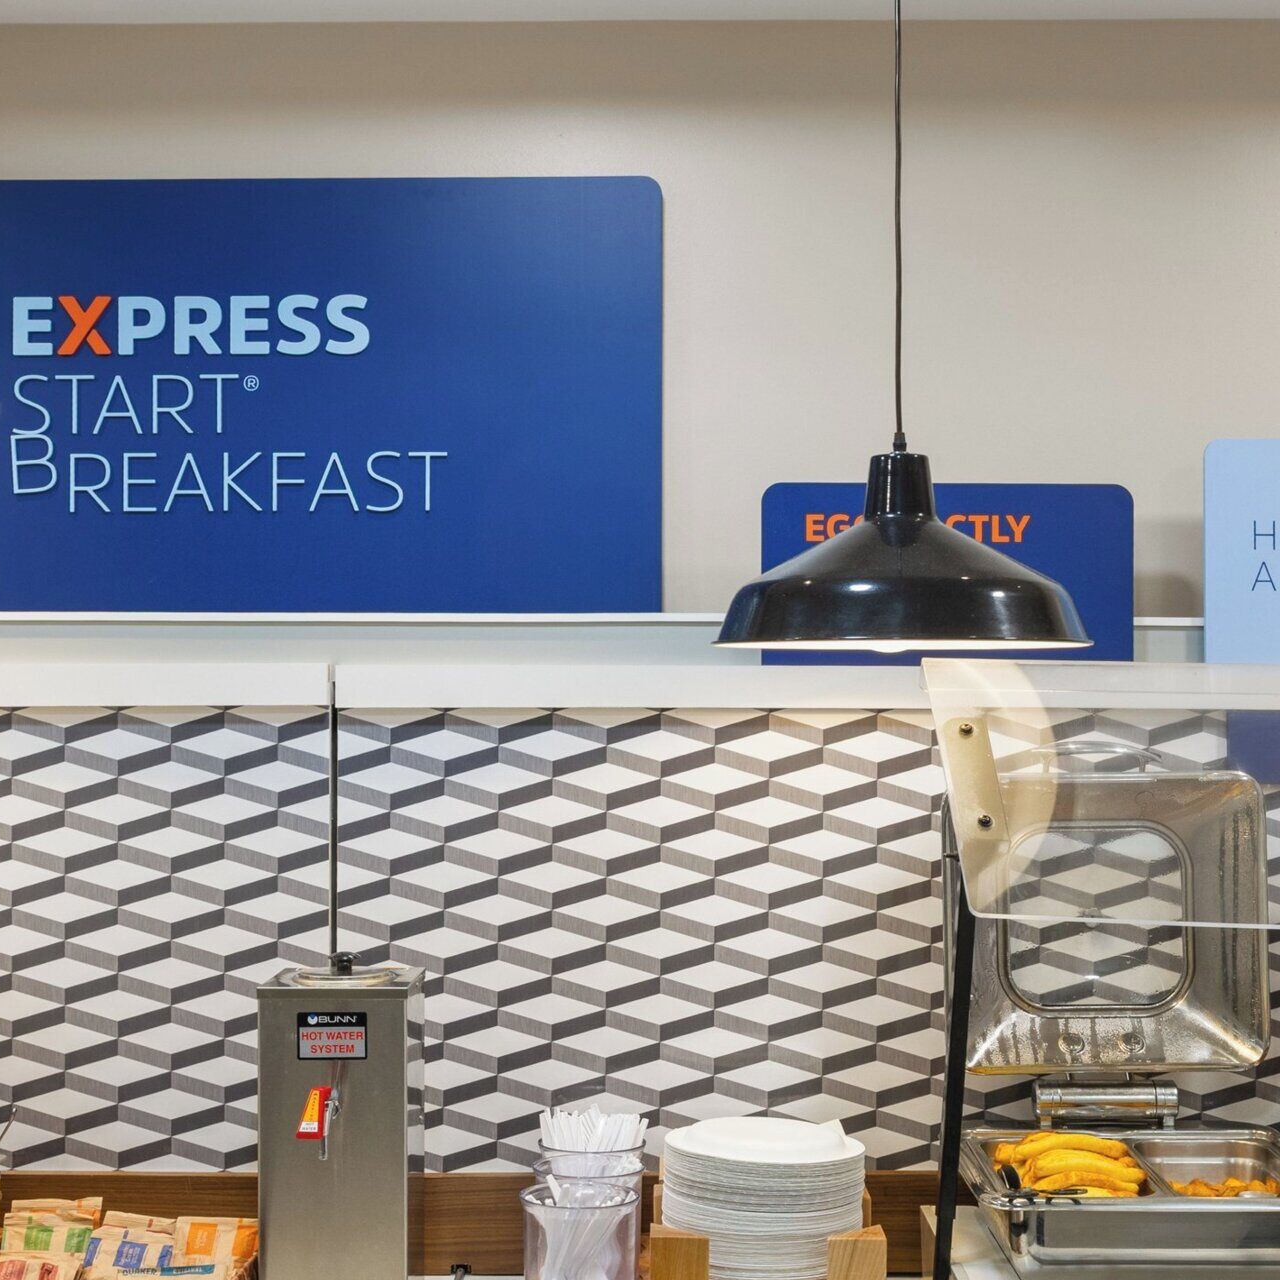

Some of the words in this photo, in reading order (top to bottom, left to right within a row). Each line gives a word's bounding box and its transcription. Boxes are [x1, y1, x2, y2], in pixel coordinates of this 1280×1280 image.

[12, 294, 371, 357] EXPRESS
[10, 433, 449, 514] BREAKFAST
[1251, 562, 1277, 592] A
[301, 1032, 323, 1040] HOT
[326, 1032, 363, 1040] WATER
[310, 1045, 355, 1053] SYSTEM
